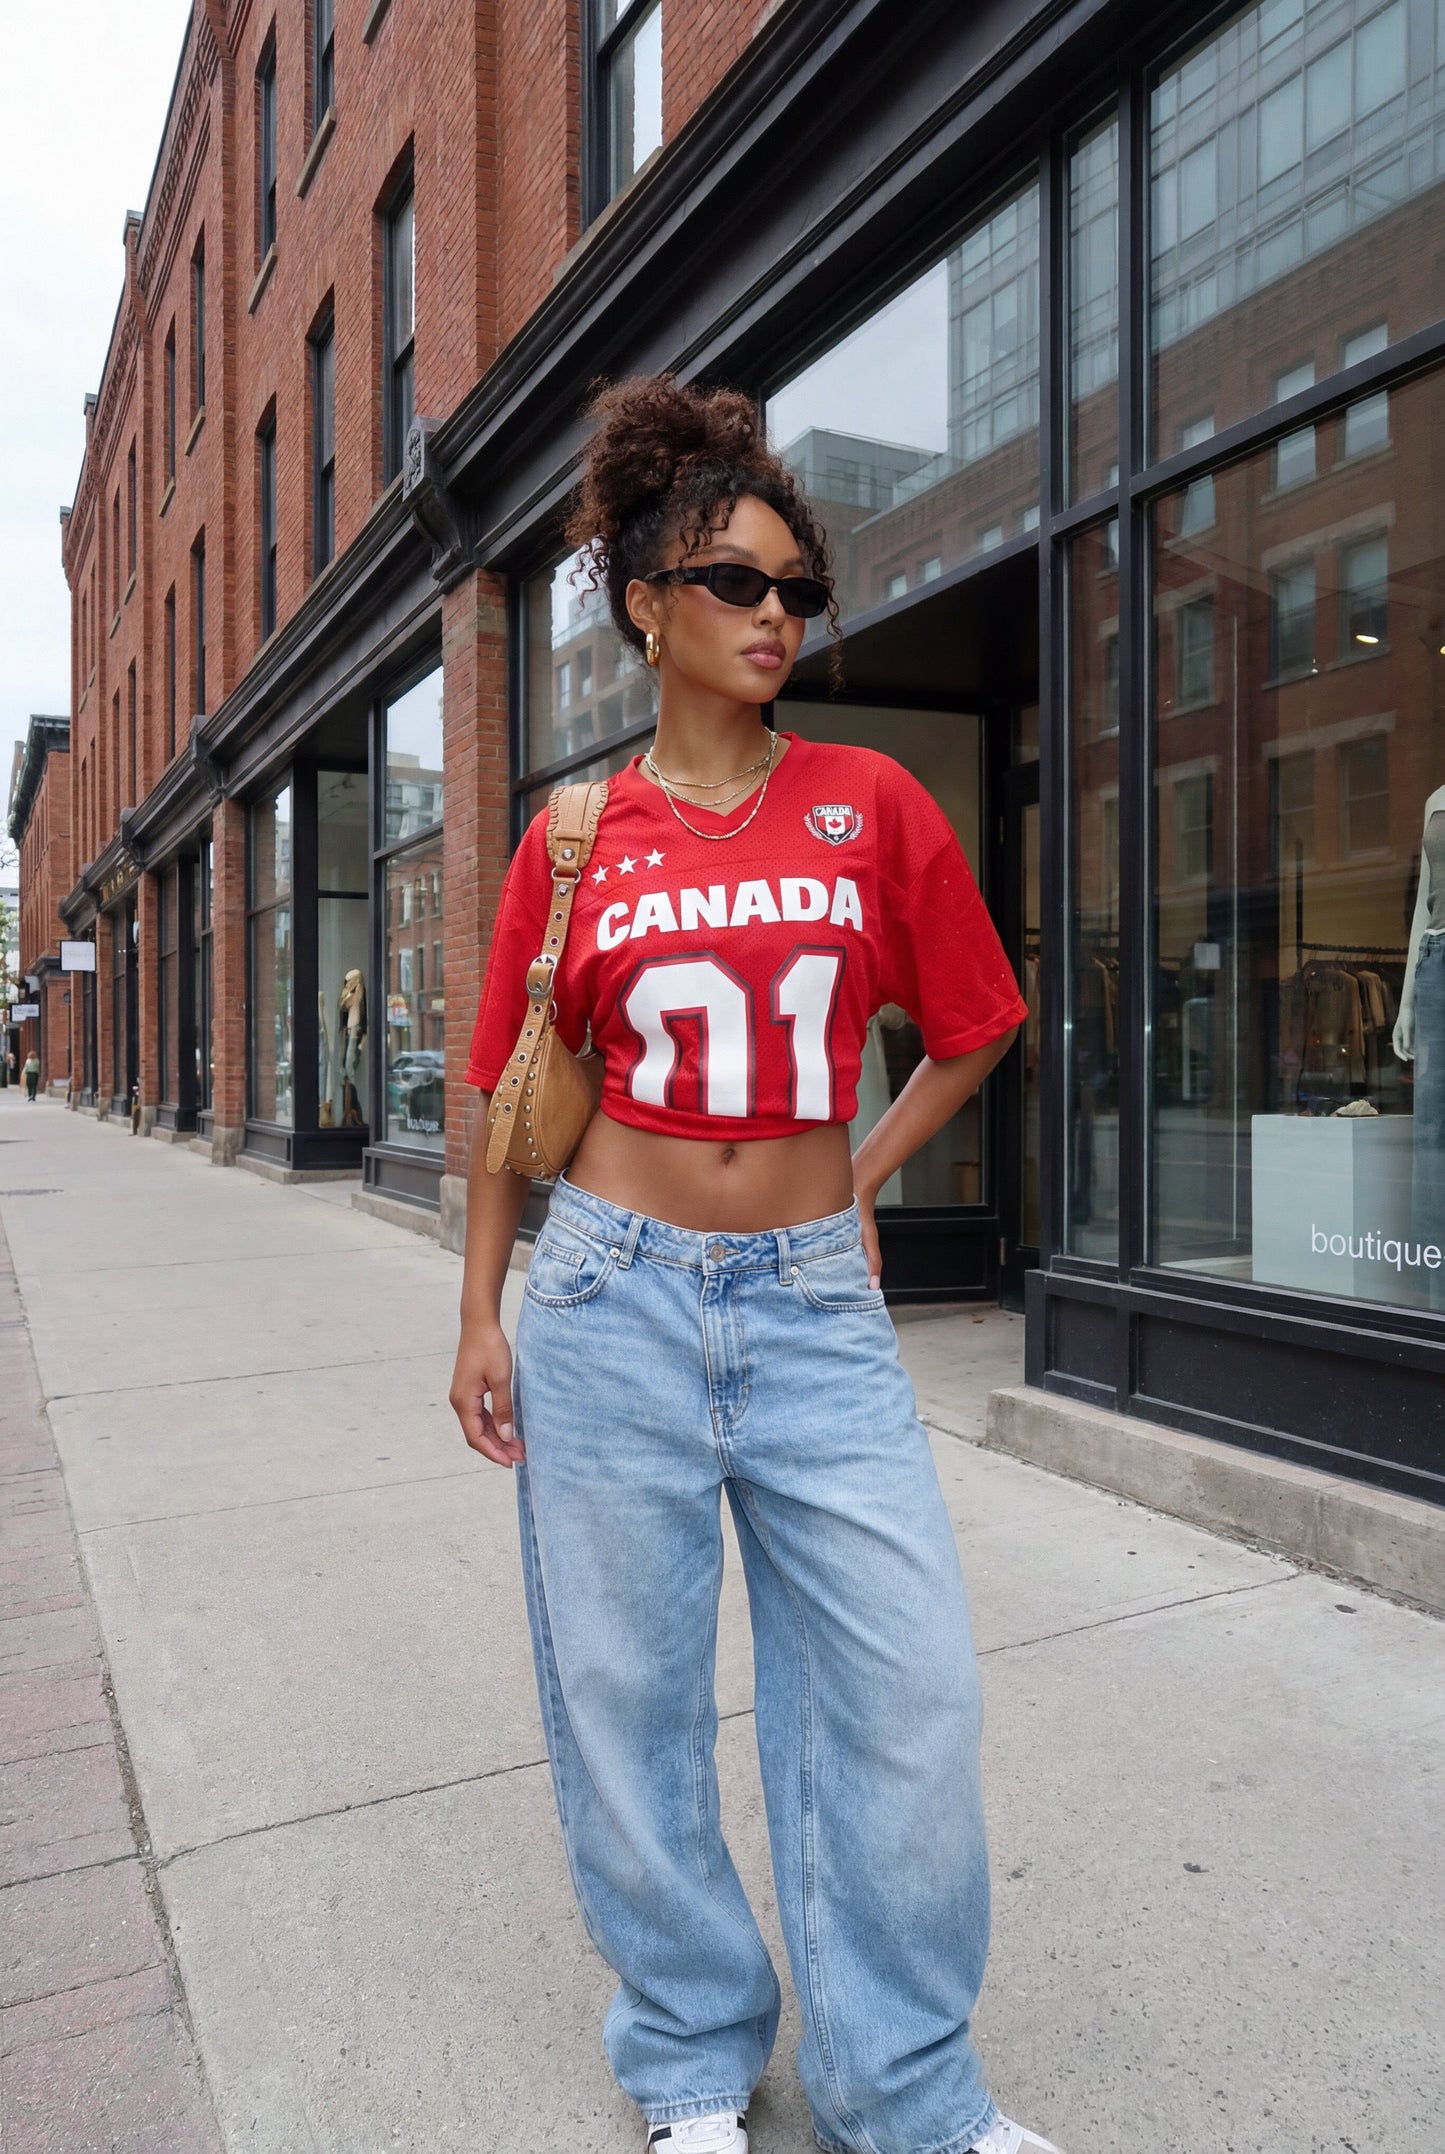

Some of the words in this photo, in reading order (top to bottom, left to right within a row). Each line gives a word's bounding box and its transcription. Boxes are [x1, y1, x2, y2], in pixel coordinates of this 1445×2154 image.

[815, 807, 851, 816] CANADA
[596, 876, 863, 951] CANADA
[1311, 1223, 1442, 1272] boutique
